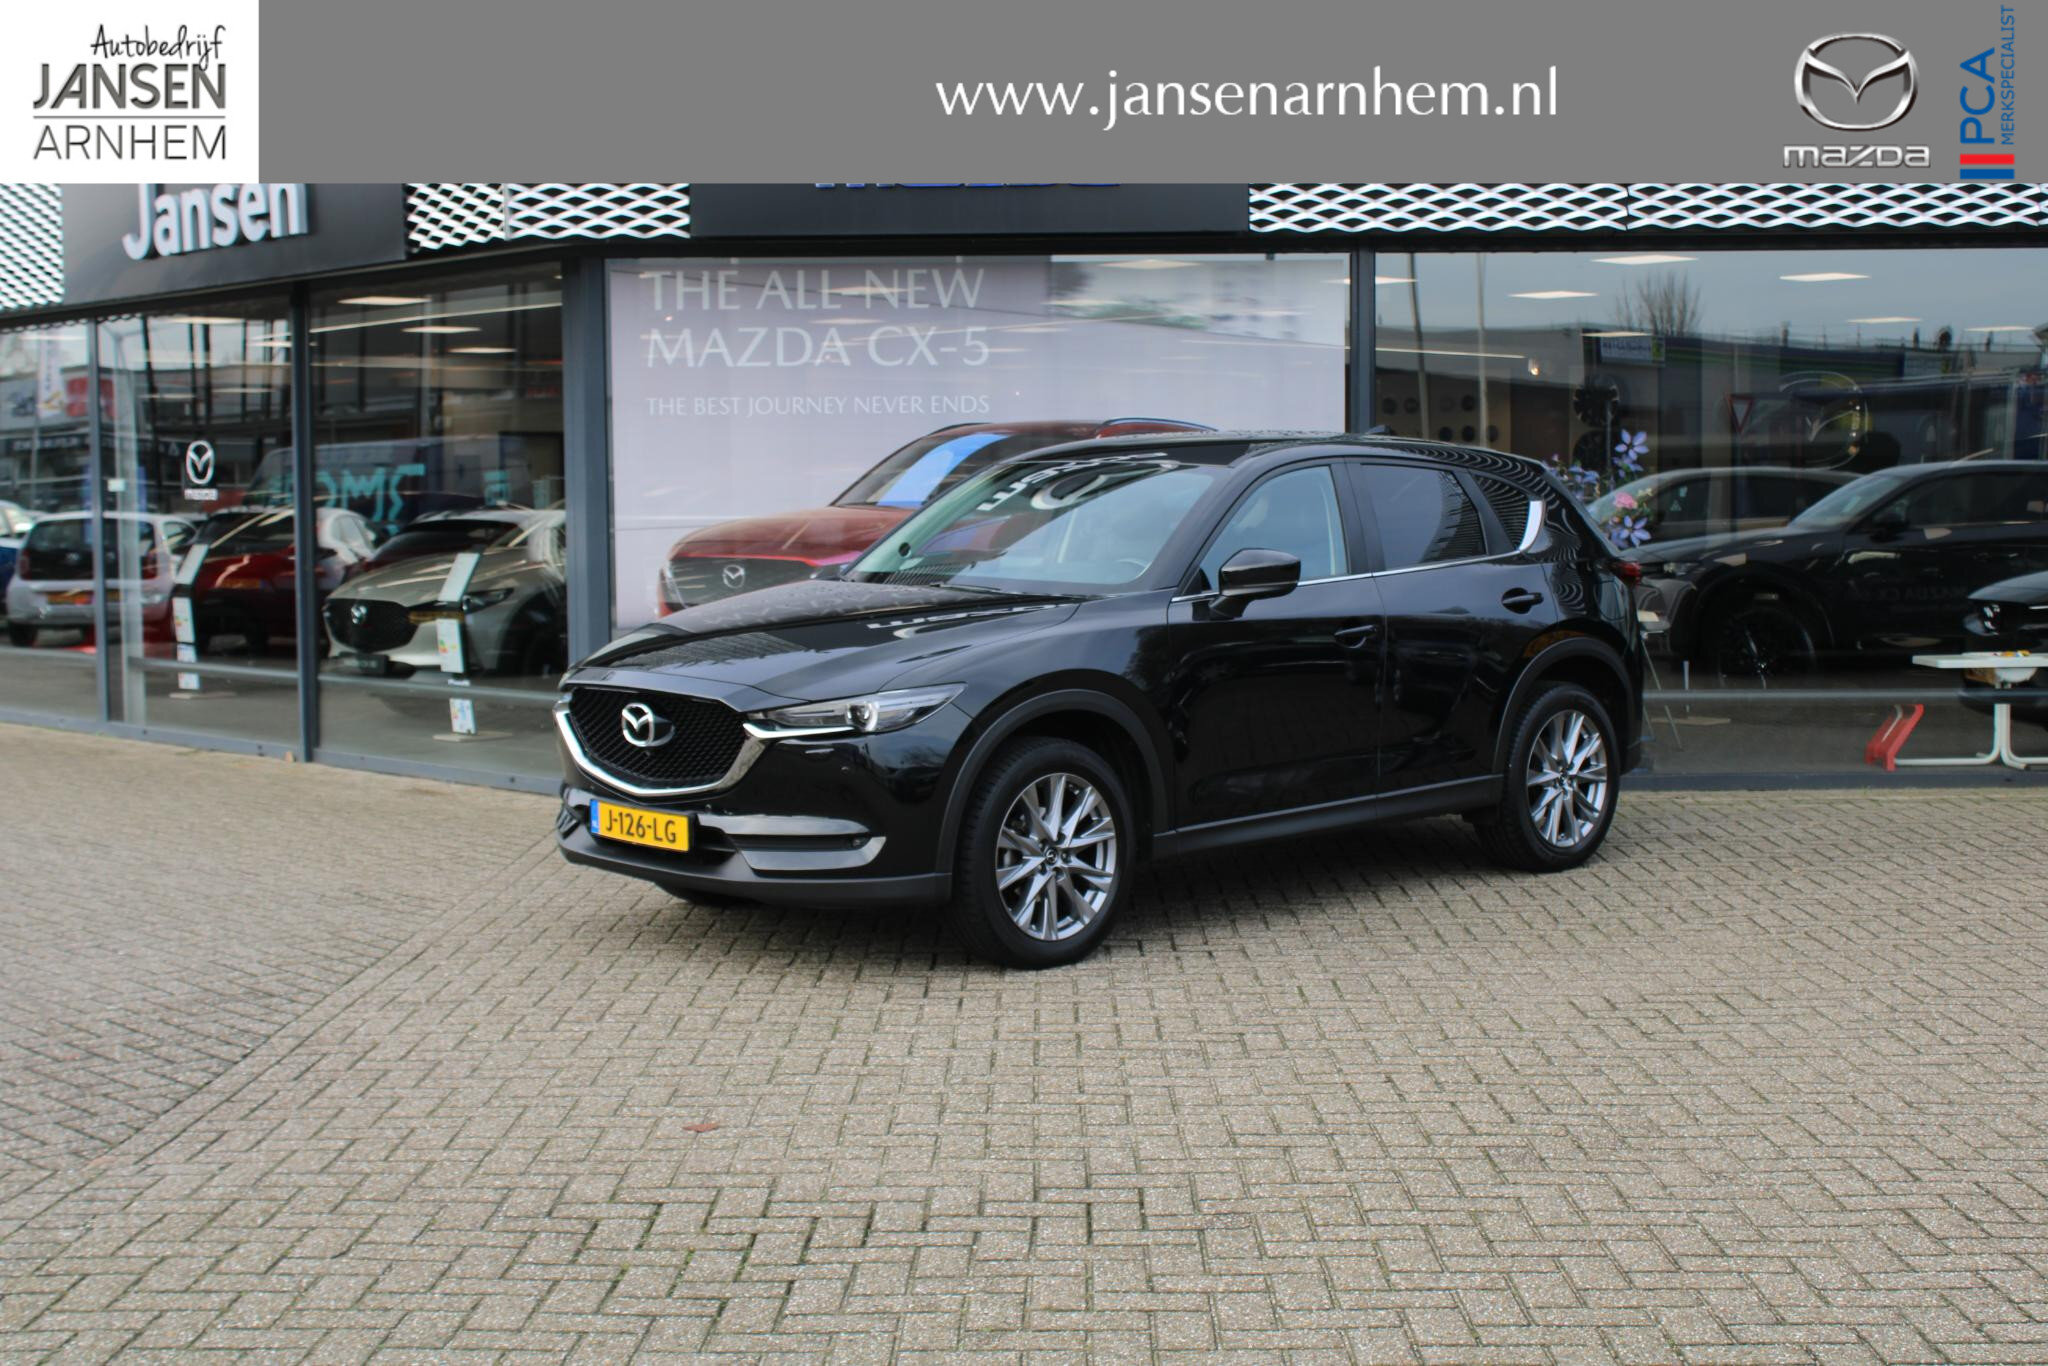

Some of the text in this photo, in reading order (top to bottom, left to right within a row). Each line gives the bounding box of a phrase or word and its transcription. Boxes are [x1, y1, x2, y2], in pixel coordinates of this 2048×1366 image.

[121, 184, 308, 260] Jansen
[649, 268, 985, 311] THE ALL NEW
[647, 325, 990, 368] MAZDA CX-5
[648, 395, 990, 418] THE BEST JOURNEY NEVER ENDS
[606, 809, 677, 844] J-126-LG
